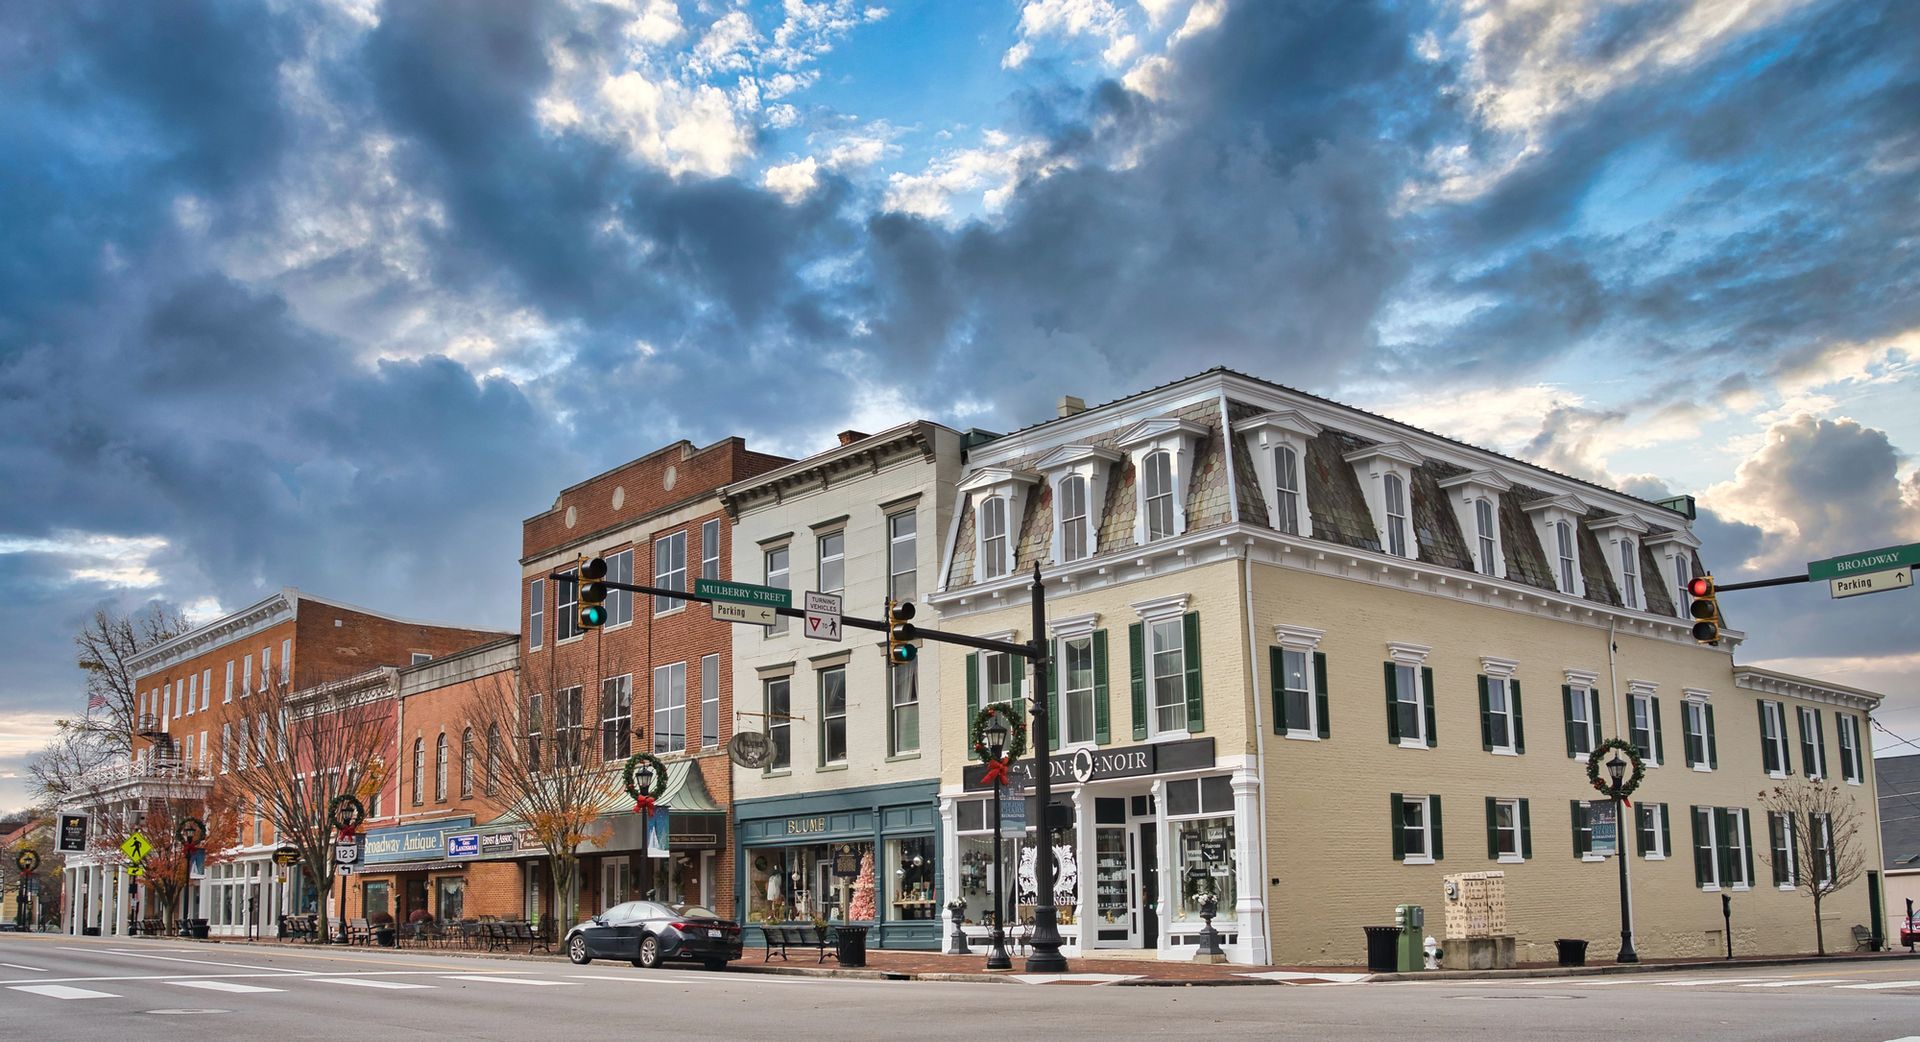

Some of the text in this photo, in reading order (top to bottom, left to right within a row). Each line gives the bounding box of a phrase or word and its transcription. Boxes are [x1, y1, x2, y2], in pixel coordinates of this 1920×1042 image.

[1836, 552, 1900, 571] BROADWAY
[1837, 579, 1872, 592] Parking
[701, 584, 787, 603] MULBERRY STREET
[811, 596, 836, 606] TURNING
[717, 604, 746, 618] Parking
[810, 603, 837, 613] VEHICLES
[822, 622, 829, 630] TO
[1101, 751, 1148, 772] NOIR
[788, 817, 826, 834] BLUME
[403, 832, 437, 851] Antique
[338, 849, 355, 859] 123
[1053, 896, 1077, 906] NOIR
